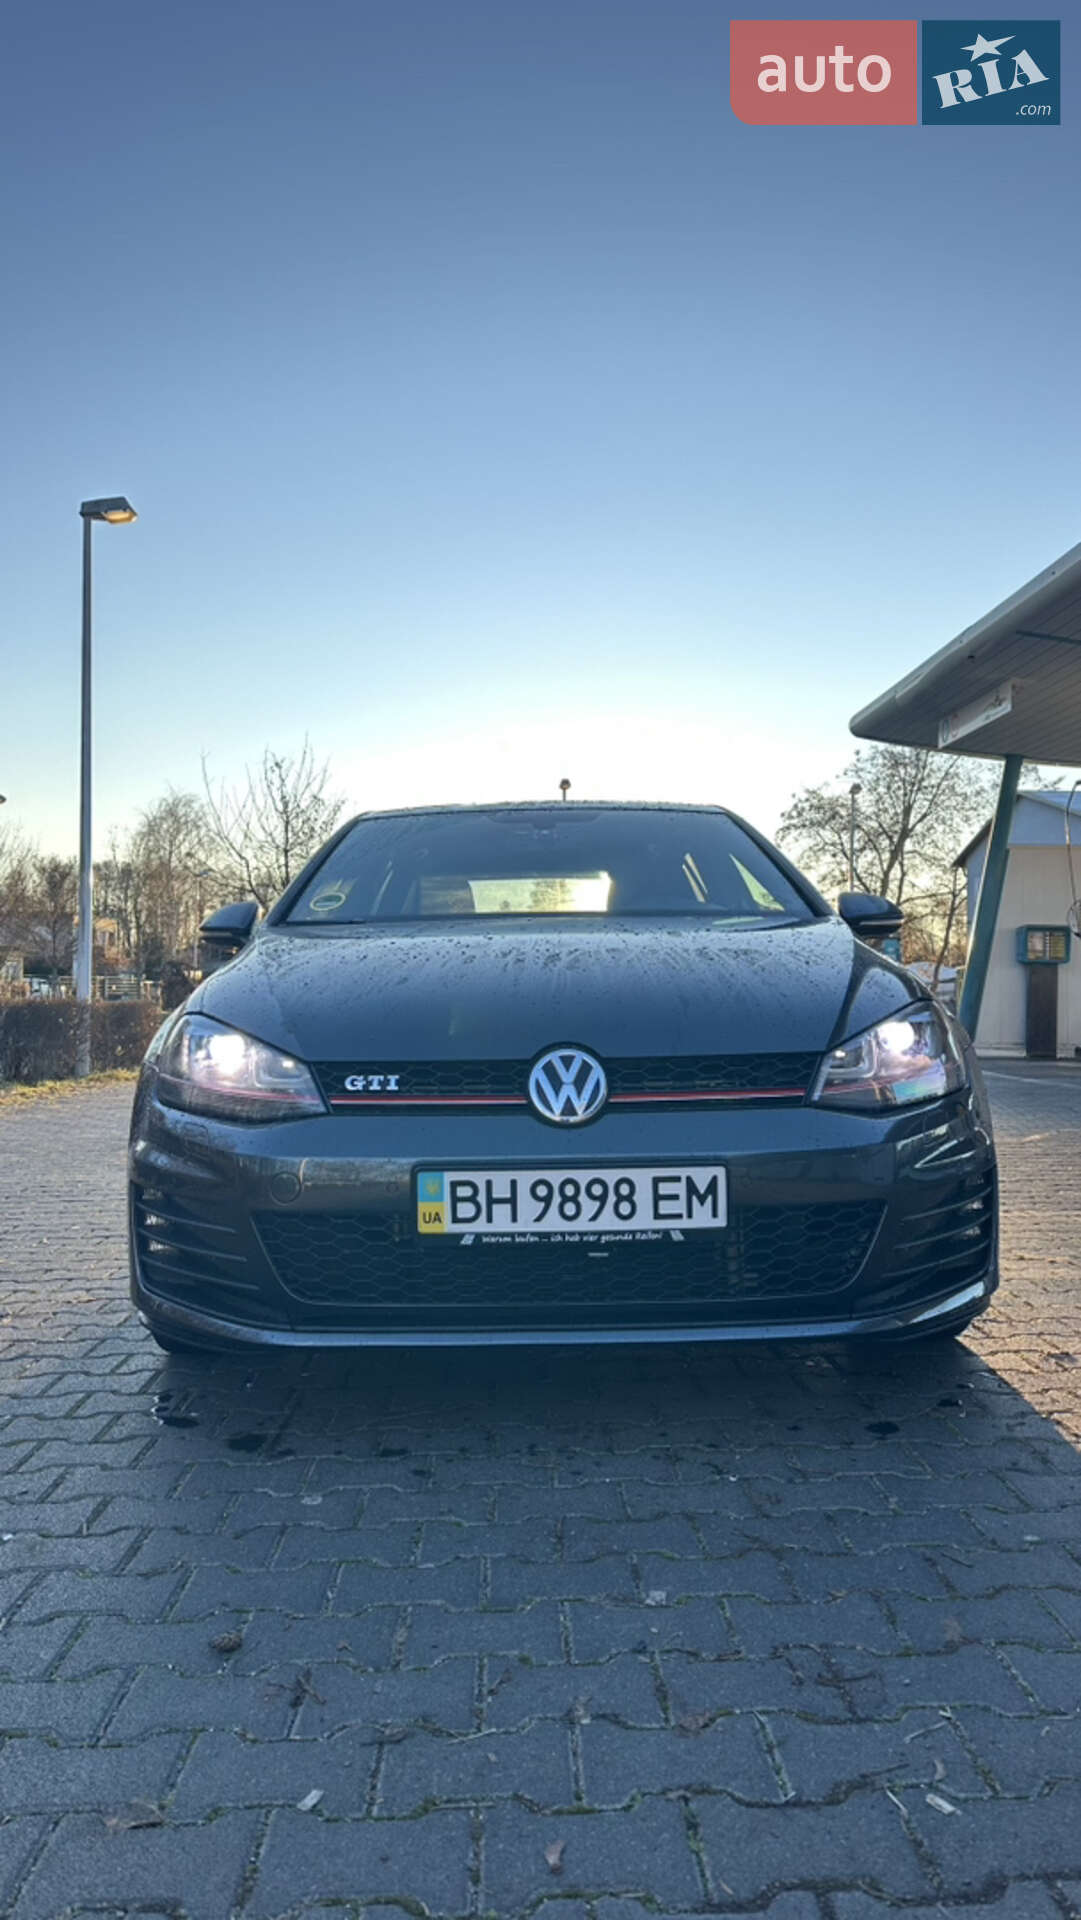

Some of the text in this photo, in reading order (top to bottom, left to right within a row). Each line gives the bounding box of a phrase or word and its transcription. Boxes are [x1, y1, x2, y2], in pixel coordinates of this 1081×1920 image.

[344, 1075, 400, 1091] GTI
[450, 1175, 719, 1224] BH 9898 EM
[422, 1211, 442, 1224] UA
